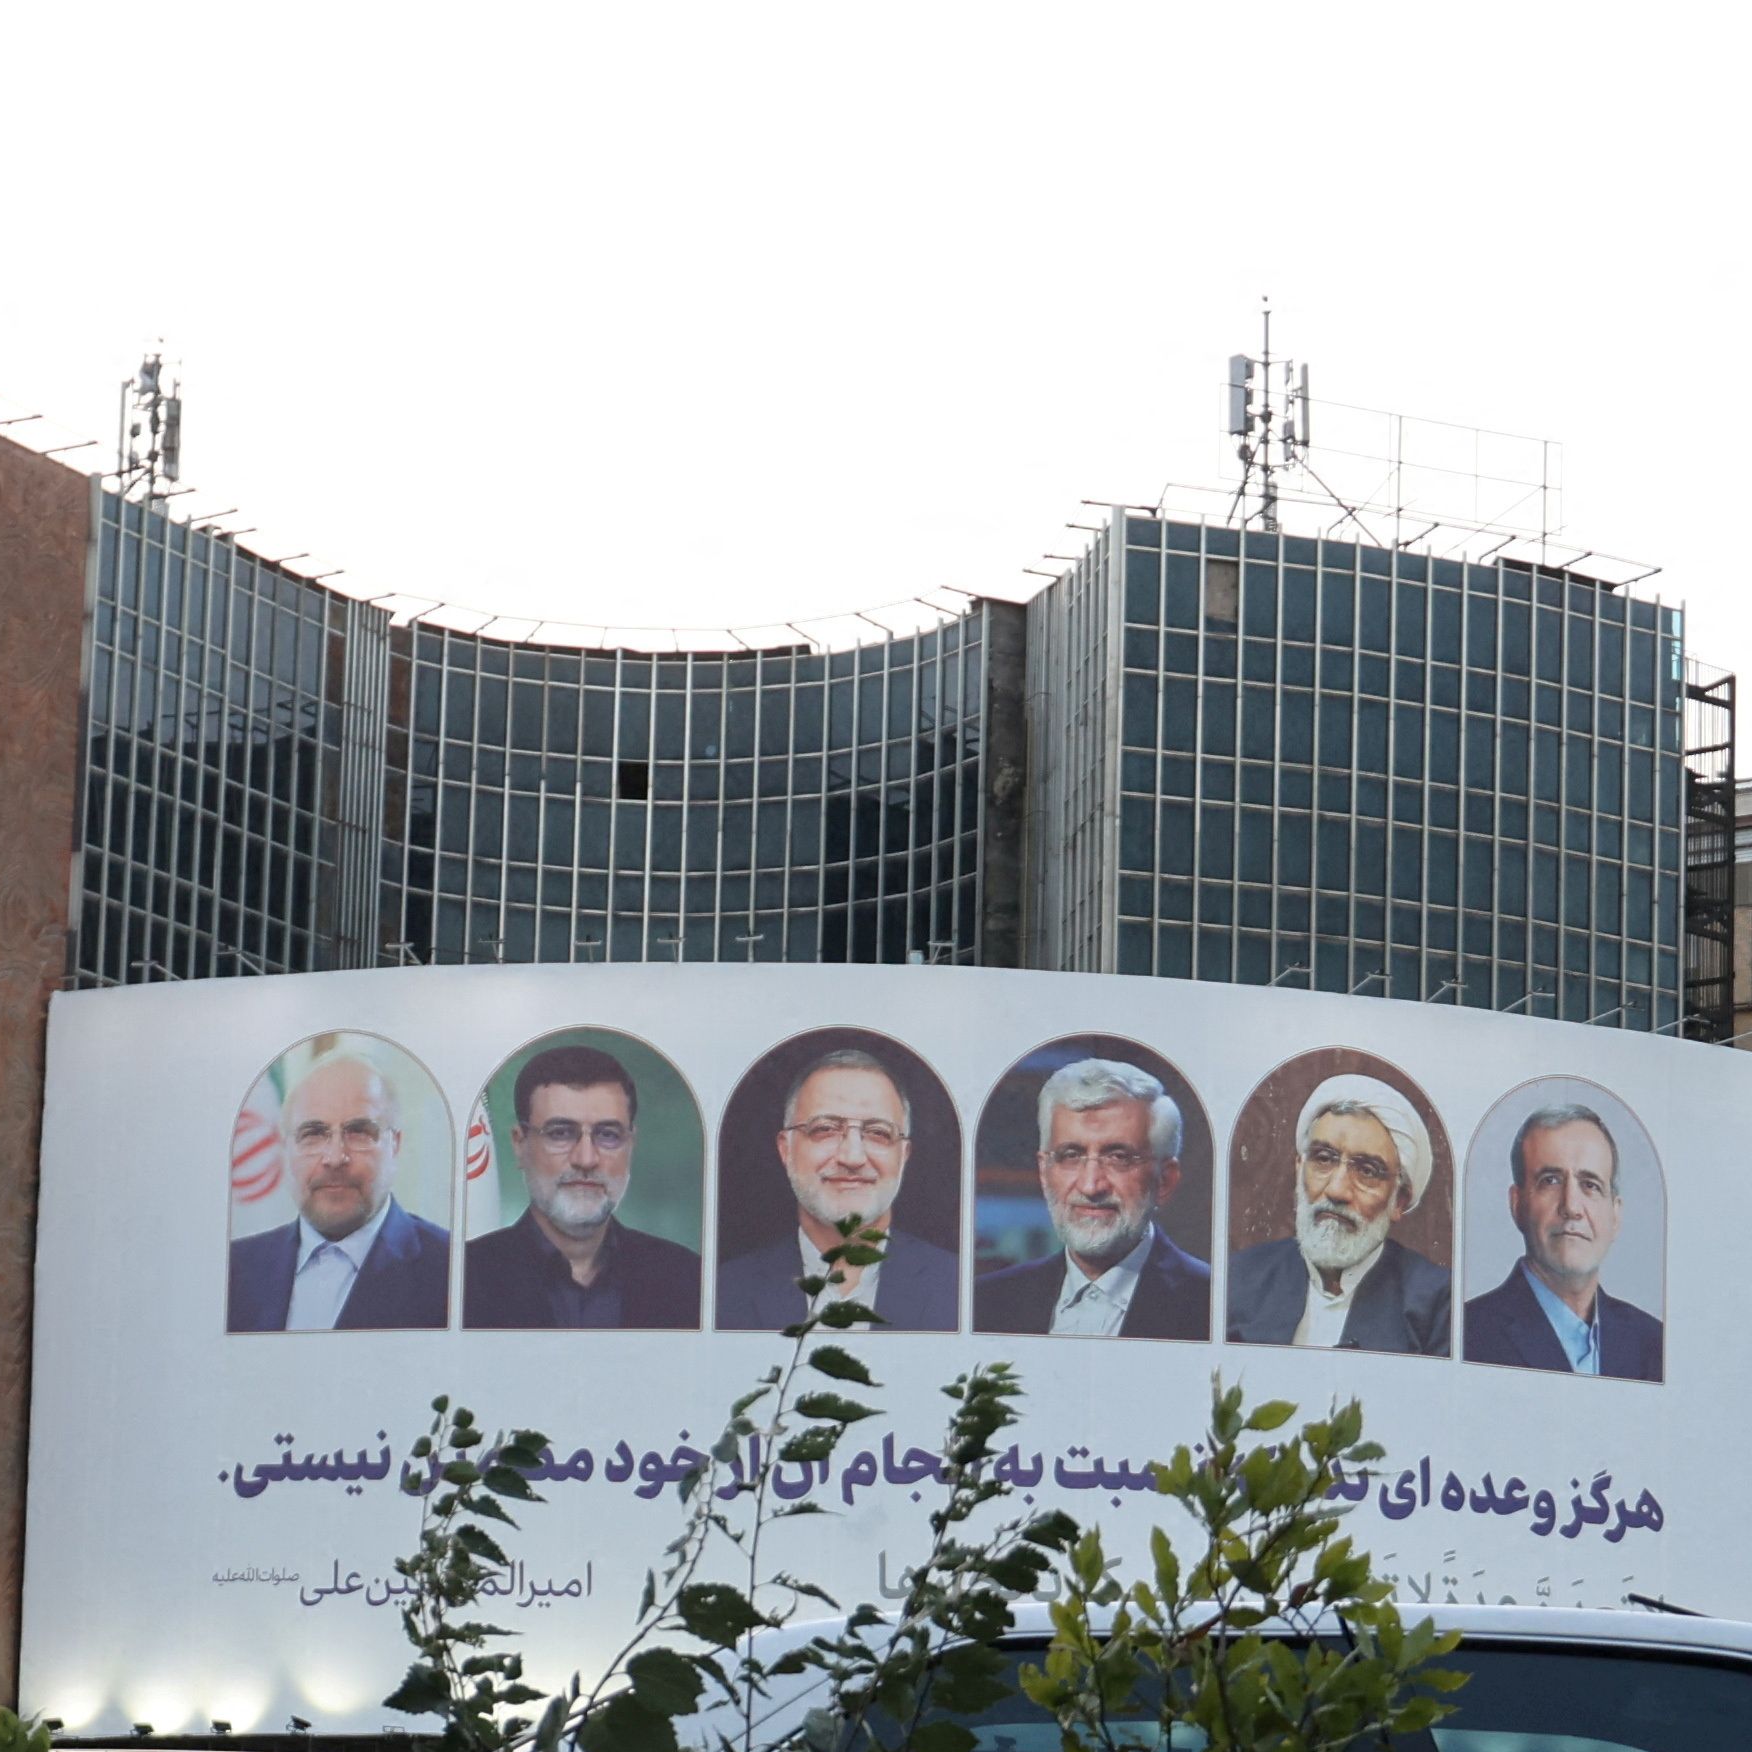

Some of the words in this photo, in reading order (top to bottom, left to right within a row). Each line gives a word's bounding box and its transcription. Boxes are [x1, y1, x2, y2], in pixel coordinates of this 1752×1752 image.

[217, 1428, 392, 1499] نیستی.
[603, 1427, 711, 1500] خود
[992, 1443, 1045, 1506] به
[1378, 1454, 1432, 1521] ای
[1440, 1470, 1558, 1538] وعده
[1558, 1468, 1666, 1544] هرگز
[299, 1558, 364, 1607] علی
